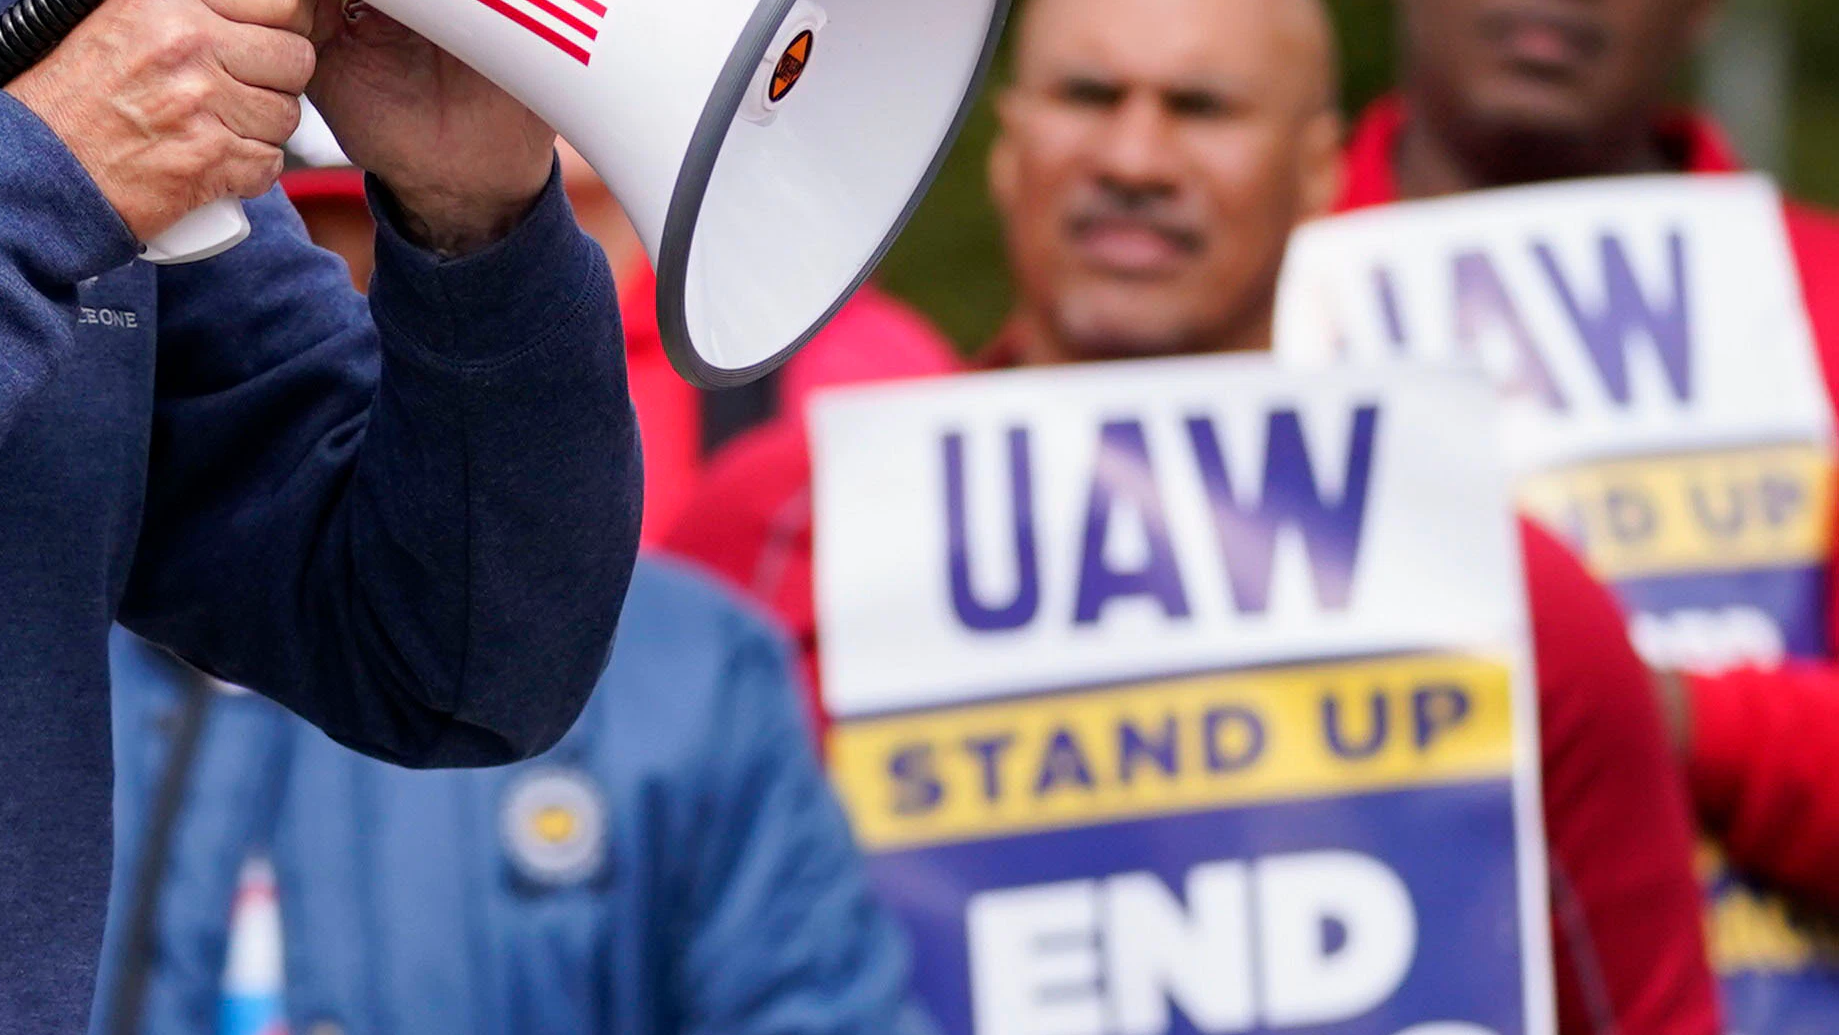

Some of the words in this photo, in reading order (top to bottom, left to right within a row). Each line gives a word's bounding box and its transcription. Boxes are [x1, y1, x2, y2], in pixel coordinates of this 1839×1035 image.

[939, 404, 1382, 633] UAW
[1689, 476, 1803, 538] UP
[886, 704, 1266, 816] STAND
[1320, 682, 1472, 761] UP
[966, 849, 1417, 1035] END
